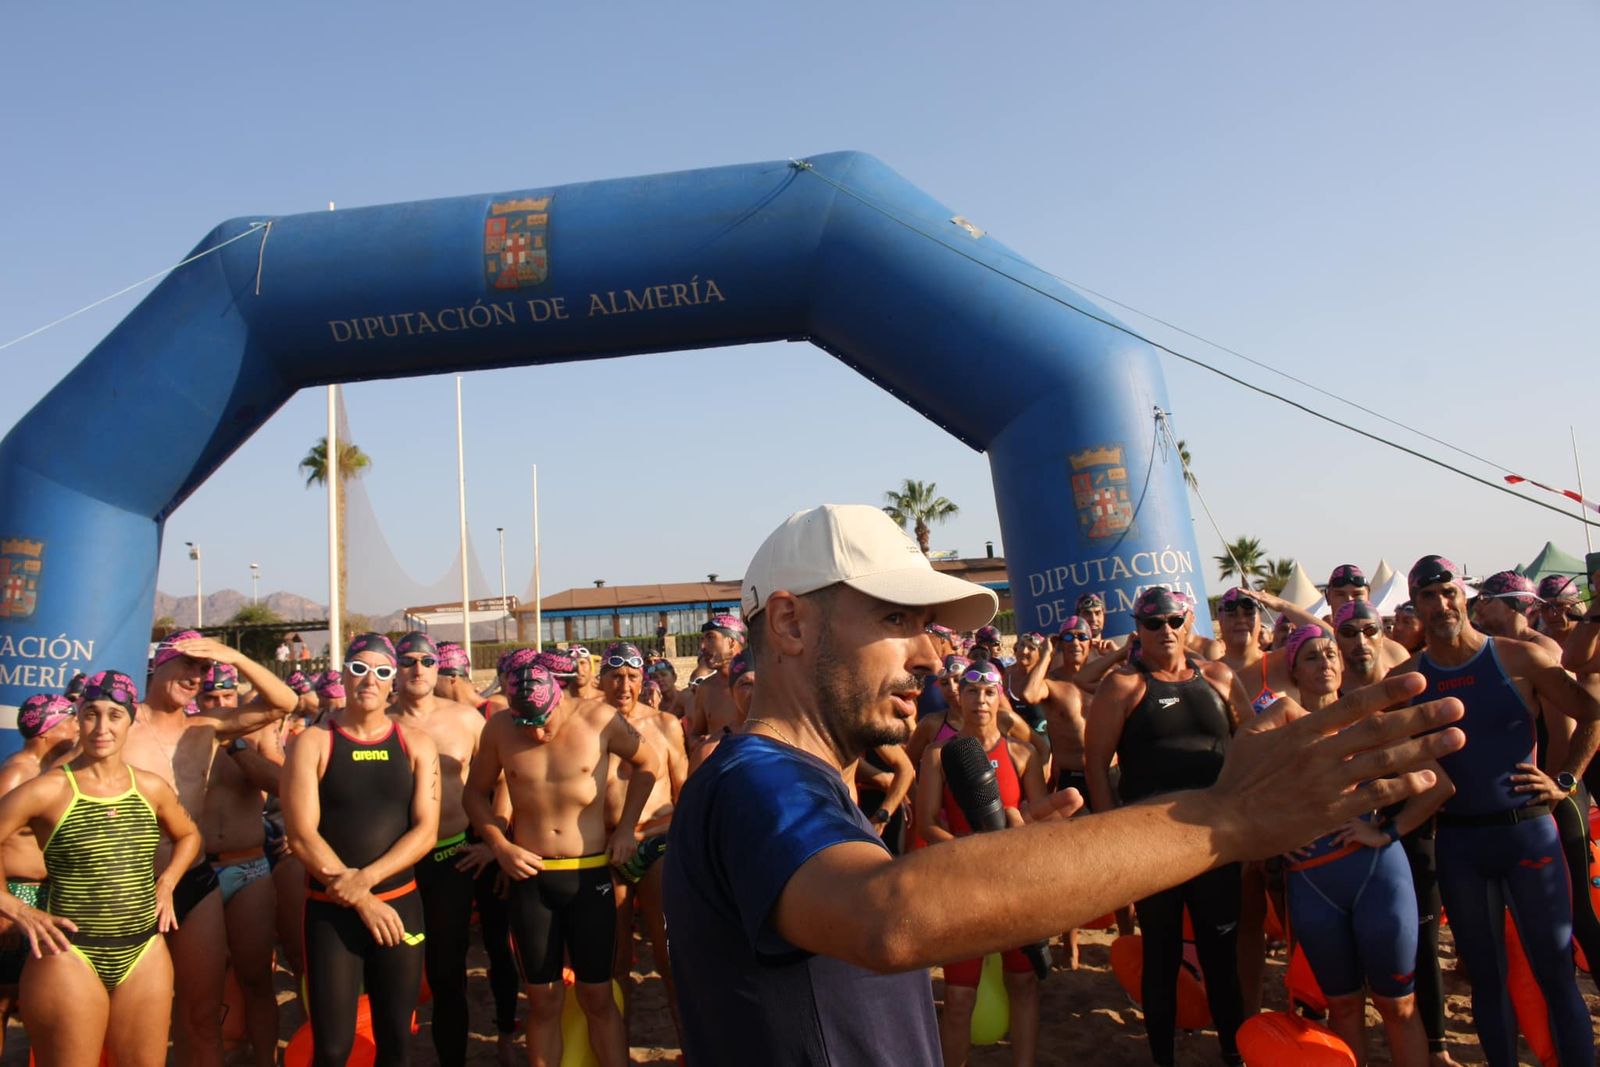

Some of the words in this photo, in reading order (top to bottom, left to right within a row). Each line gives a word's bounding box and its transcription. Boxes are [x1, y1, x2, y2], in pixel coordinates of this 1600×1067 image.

[328, 299, 517, 342] DIPUTACIÓN
[528, 297, 570, 322] DE
[587, 275, 726, 317] ALMERÍA
[1029, 545, 1194, 598] DIPUTACIÓN
[1036, 599, 1067, 628] DE
[0, 633, 95, 661] ACIÓN
[0, 662, 81, 689] MERÍ
[352, 750, 389, 761] arena
